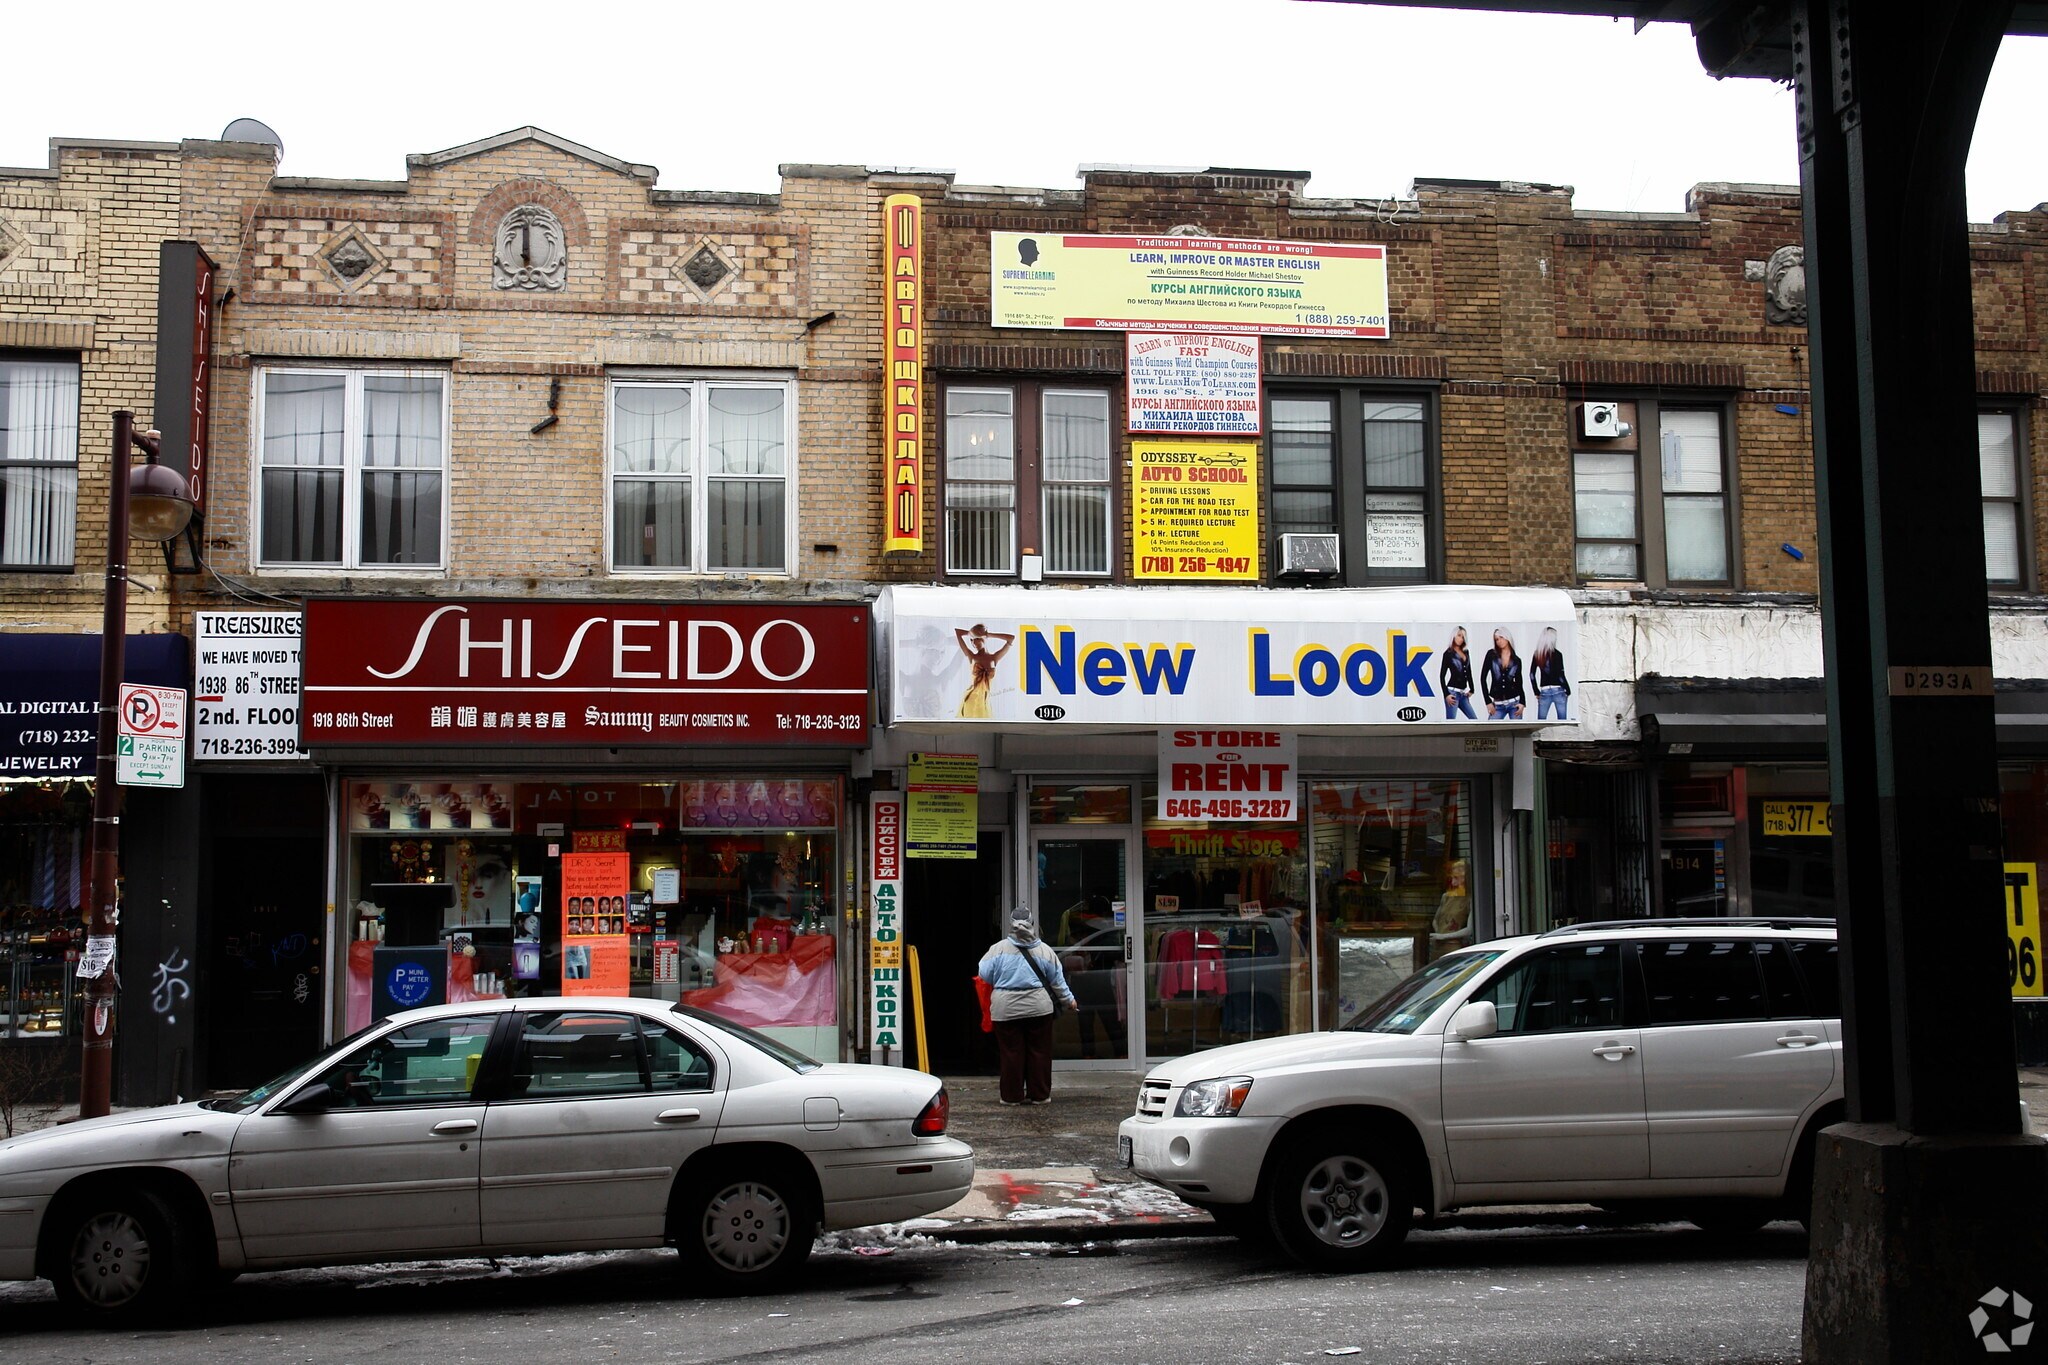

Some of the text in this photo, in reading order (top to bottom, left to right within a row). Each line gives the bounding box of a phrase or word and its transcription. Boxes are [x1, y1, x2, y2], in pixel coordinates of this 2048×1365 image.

[1136, 239, 1182, 247] Traditional
[1187, 240, 1222, 250] learning
[1227, 241, 1261, 251] methods
[1285, 245, 1313, 254] wrong!
[1130, 253, 1320, 270] LEARN, IMPROVE OR MASTER ENGLISH
[1166, 268, 1199, 276] Guinness
[1200, 269, 1224, 277] Record
[1225, 270, 1247, 278] Holder
[1249, 271, 1274, 279] Michael
[1275, 272, 1301, 281] Shestov
[1151, 283, 1302, 299] КУРСЫ АНГЛИЙСКОГО ЯЗЫКА
[1138, 298, 1325, 312] методу Михаила Шестова Книги Рекордов Гиннесса
[1095, 319, 1128, 328] Обычные
[1130, 321, 1155, 329] методы
[1156, 322, 1187, 330] изучения
[1194, 323, 1259, 332] совершенствования
[1295, 314, 1385, 326] 1 (888) 259-7401
[1134, 335, 1254, 357] LEARN or IMPROVE ENGLISH
[1180, 347, 1209, 357] FAST
[1130, 357, 1257, 371] with Guinness World Champion Courses
[1153, 369, 1199, 377] TOLL-FREE:
[1201, 370, 1221, 378] (800)
[190, 271, 211, 502] SHISEIDO
[1225, 389, 1256, 397] Floor
[1131, 396, 1257, 412] КУРСЫ АНГЛИЙСКОГО ЯЗЫКА
[1142, 410, 1245, 422] МИХАИЛА ШЕСТОВА
[1131, 420, 1258, 432] ИЗ КНИГИ РЕКОРДОВ ГИННЕССА
[1140, 452, 1198, 464] ODYSSEY
[1140, 466, 1248, 483] AUTO SCHOOL
[1150, 487, 1178, 495] DRIVING
[1166, 498, 1180, 506] FOR
[1182, 498, 1195, 506] THE
[1197, 498, 1216, 506] ROAD
[1219, 498, 1236, 506] TEST
[1150, 508, 1250, 517] APPOINTMENT FOR ROAD TEST
[1150, 518, 1236, 527] 5 Hr. REQUIRED LECTURE
[1170, 530, 1200, 538] LECTURE
[1196, 546, 1229, 554] Reduction)
[1141, 556, 1251, 573] (718) 256-4947
[366, 604, 817, 681] SHISEIDO
[202, 650, 288, 664] WE HAVE MOVED
[1019, 624, 1435, 697] New Look
[199, 676, 227, 695] 1938
[260, 676, 300, 694] STREE
[1903, 672, 1973, 690] D293A
[20, 701, 90, 714] DIGITAL
[1038, 707, 1063, 719] 1916
[1400, 708, 1424, 720] 1916
[247, 707, 299, 725] FLOO
[311, 712, 394, 729] 1918 86th Street
[659, 713, 689, 727] BEAUTY
[691, 713, 734, 727] COSMETICS
[736, 713, 750, 728] INC.
[776, 713, 861, 730] Tel: 718-236-3123
[19, 730, 58, 746] (718)
[1173, 730, 1281, 748] STORE
[138, 743, 177, 753] PARKING
[0, 756, 83, 770] JEWELRY
[1222, 753, 1239, 761] FOR
[150, 762, 171, 770] SUNDAY
[1171, 763, 1290, 792] RENT
[1166, 798, 1291, 818] 646-496-3287
[1765, 805, 1785, 814] CALL
[1765, 819, 1787, 831] (718)
[877, 805, 897, 878] ОДИССЕЙ
[1169, 833, 1225, 857] Thrift
[594, 857, 617, 867] Secret
[1670, 857, 1700, 870] 1914
[876, 883, 897, 942] АВТО
[873, 968, 899, 1045] ШКОЛА
